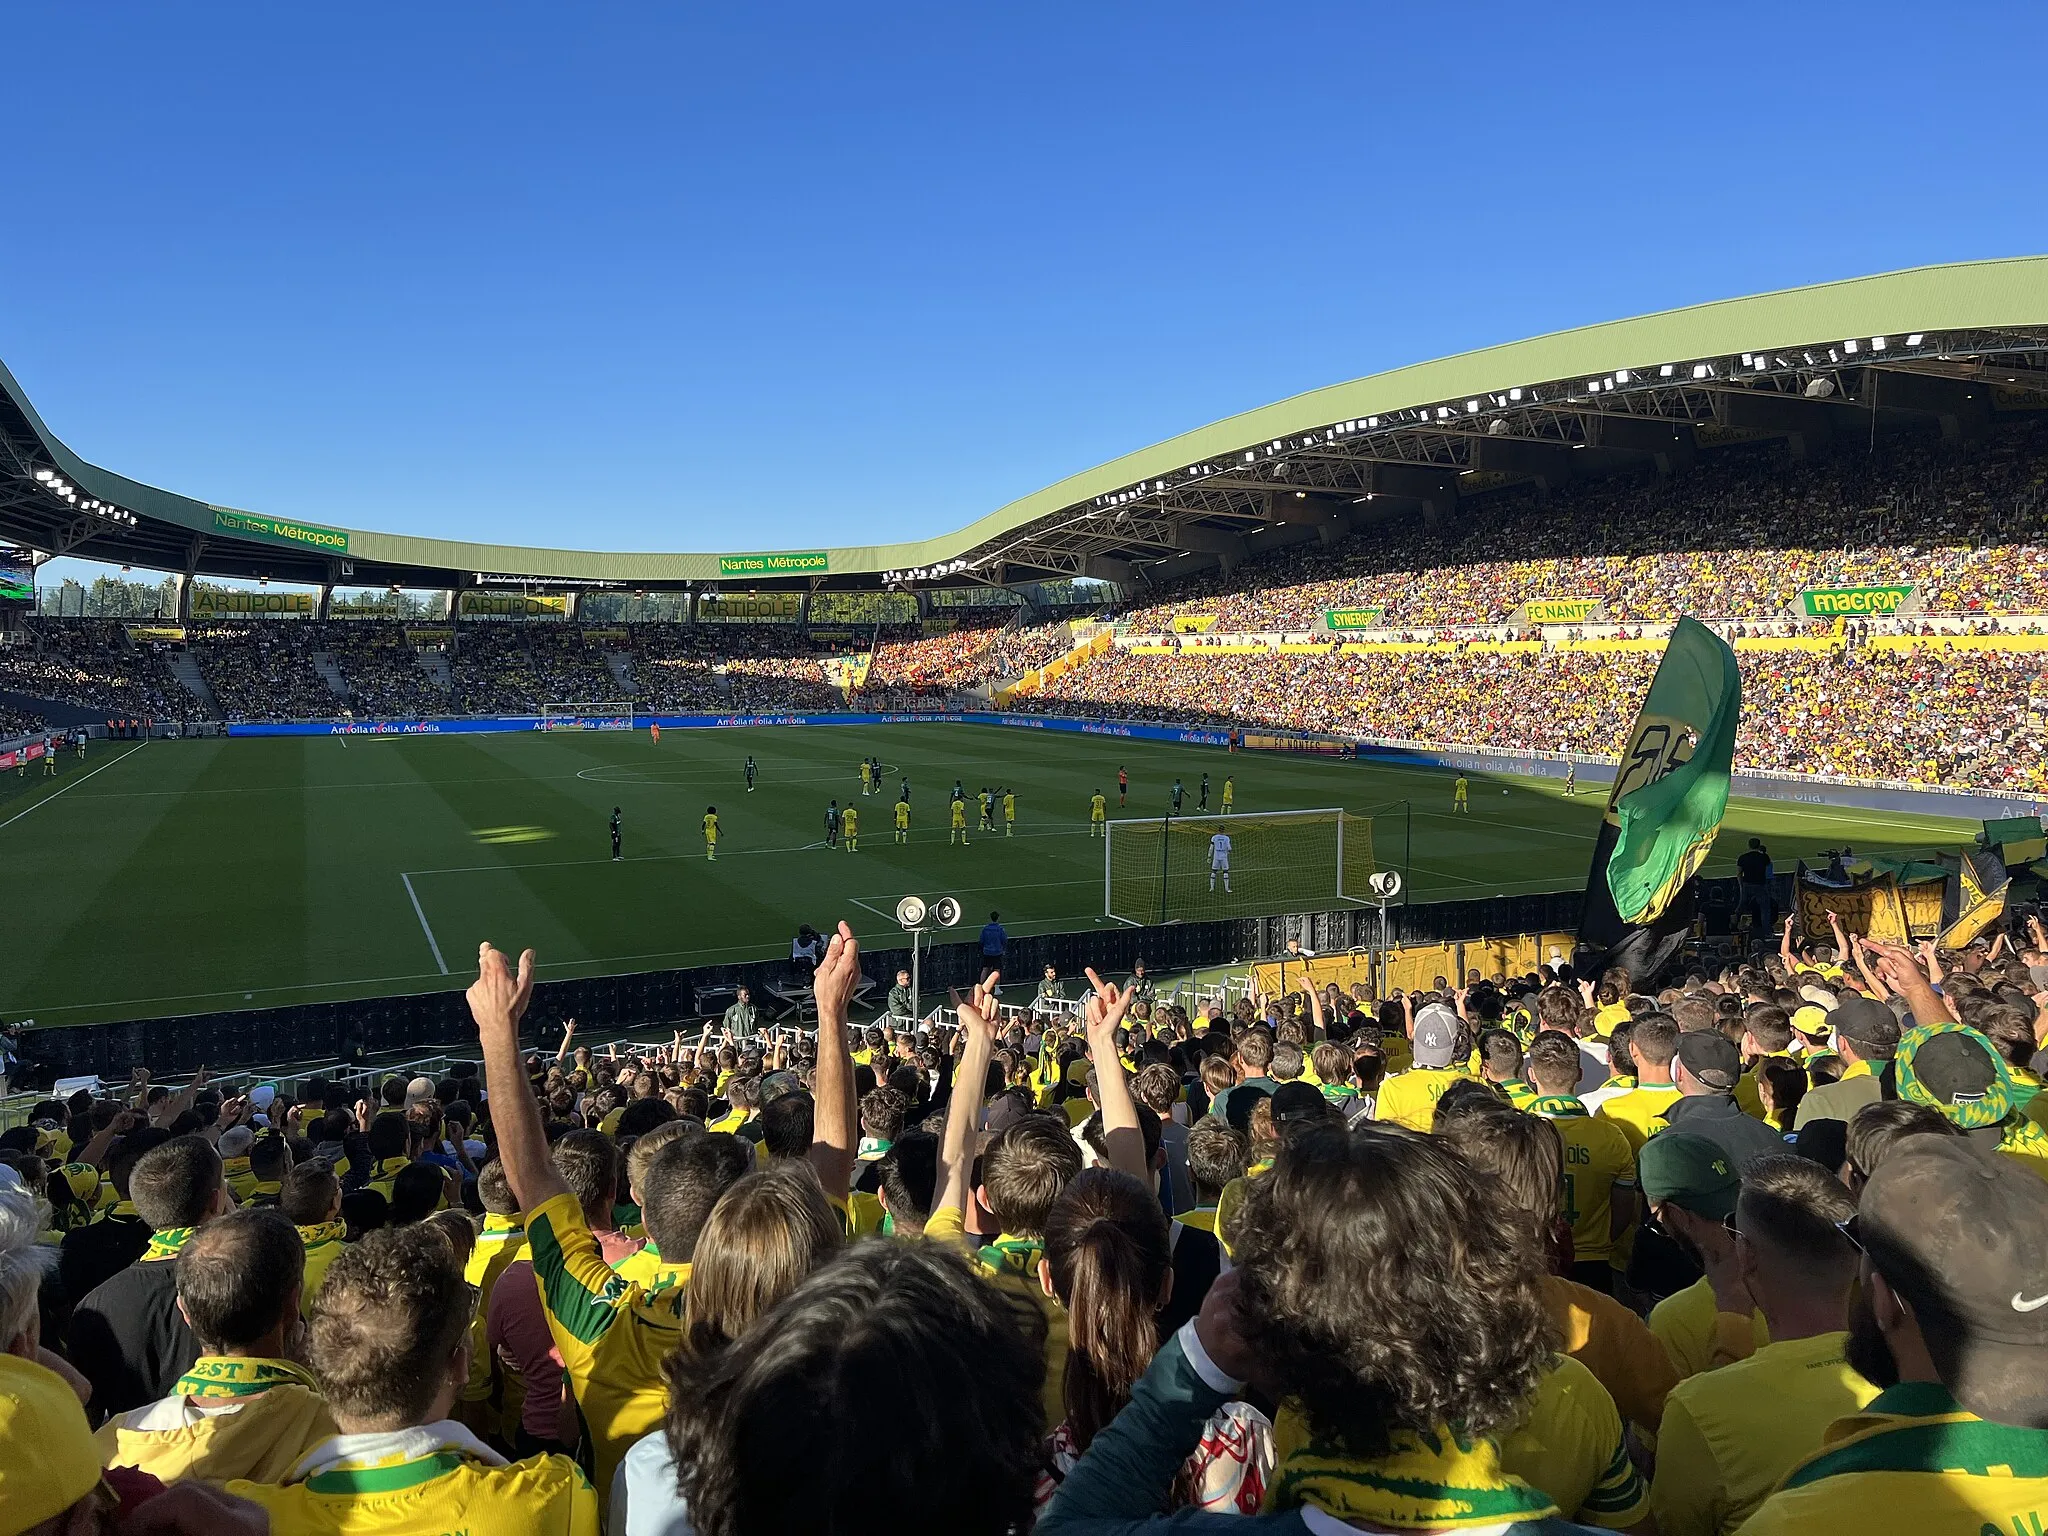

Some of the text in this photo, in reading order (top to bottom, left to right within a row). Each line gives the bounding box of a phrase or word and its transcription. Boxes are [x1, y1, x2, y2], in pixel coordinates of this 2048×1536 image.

[215, 513, 269, 534] Nantes
[721, 559, 764, 571] Nantes
[198, 593, 310, 613] ARTIPOLE
[465, 599, 564, 614] ARTIPOLE
[703, 600, 794, 616] ARTIPOLE
[1813, 591, 1904, 612] macron
[1527, 603, 1597, 618] FC NANTE
